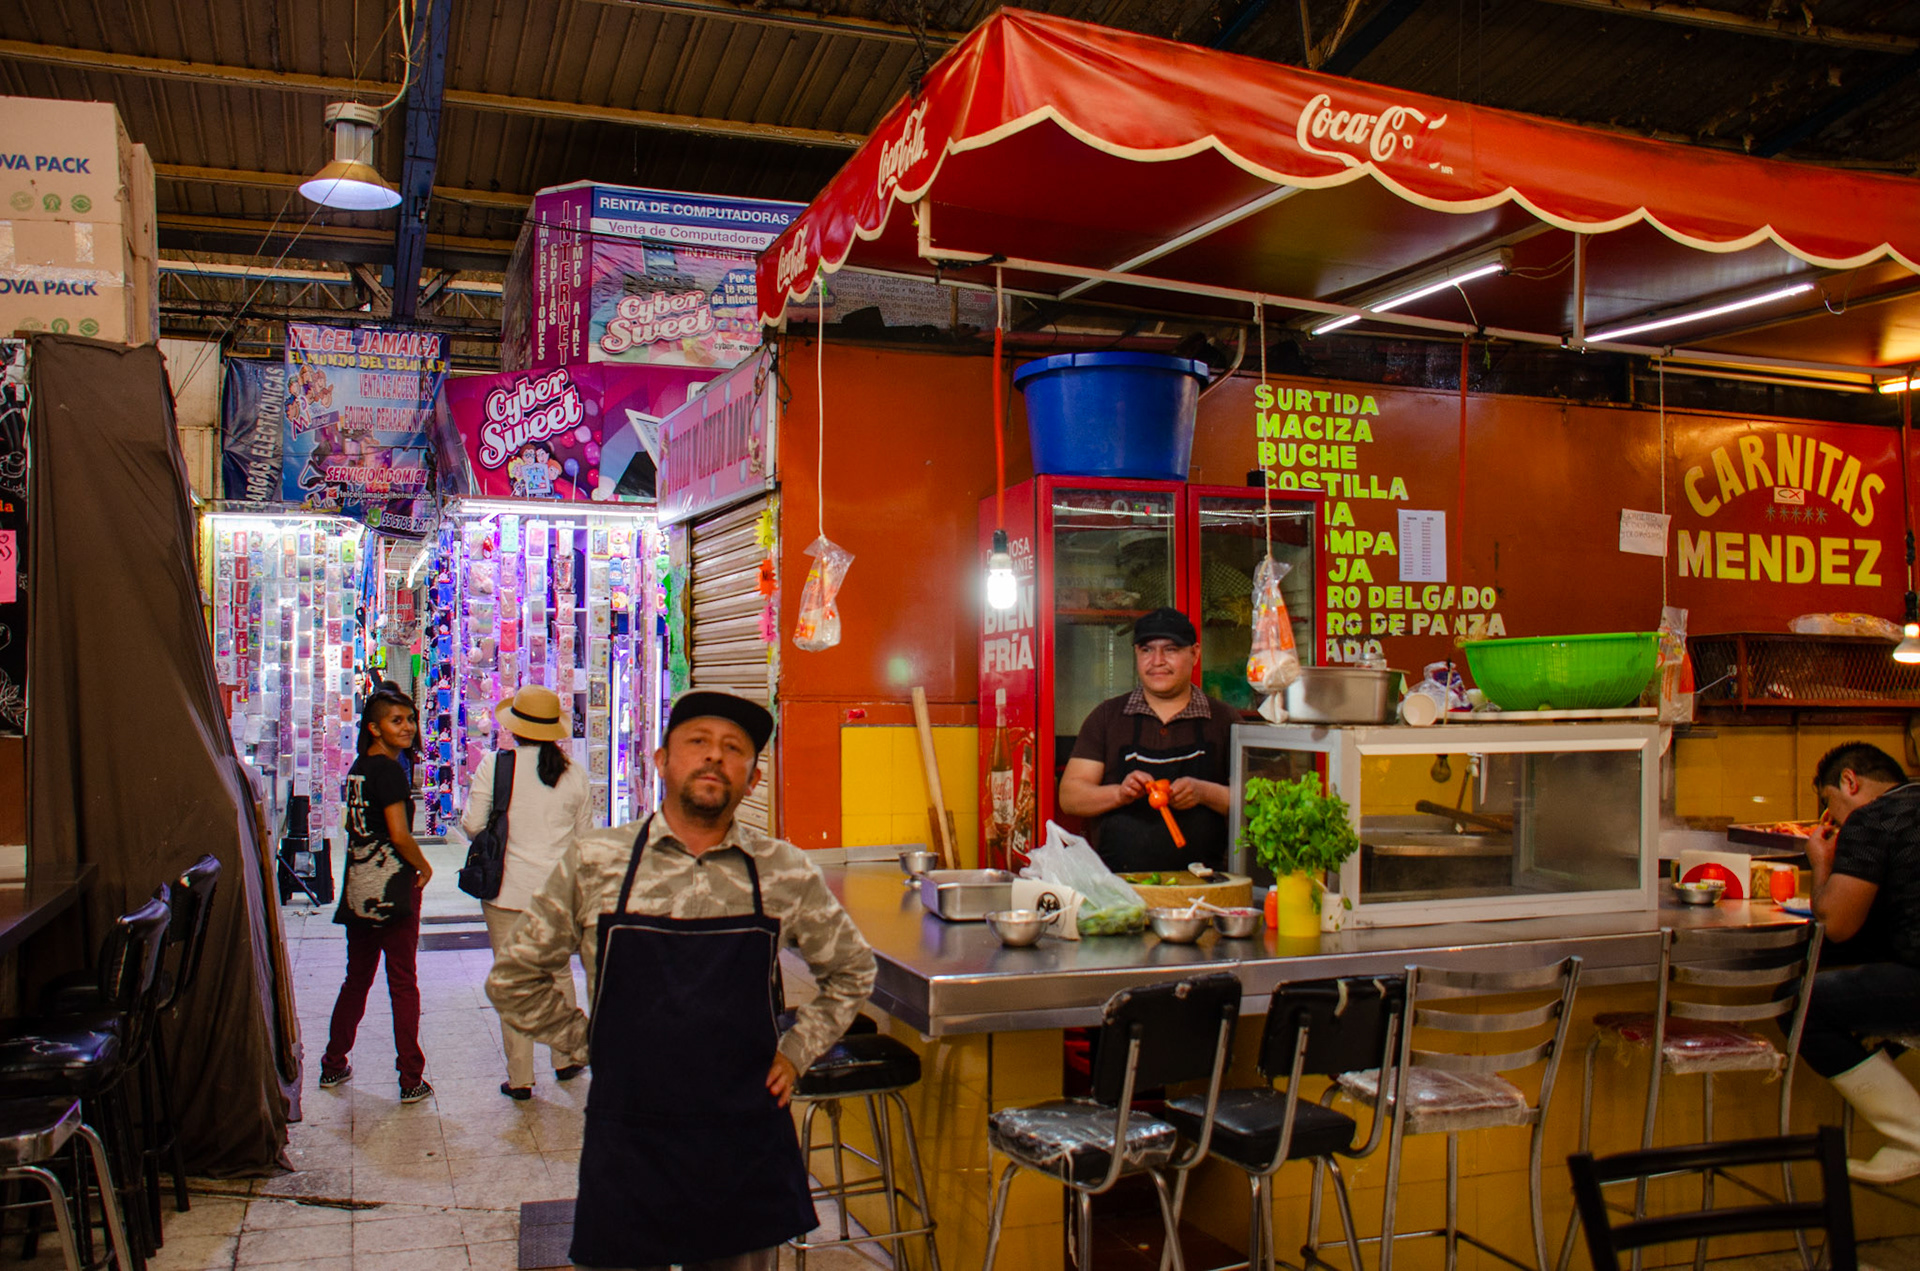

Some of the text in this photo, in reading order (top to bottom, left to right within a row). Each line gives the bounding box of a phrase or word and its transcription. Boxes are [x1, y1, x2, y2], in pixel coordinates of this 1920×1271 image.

[0, 153, 91, 174] VA PACK
[878, 97, 929, 200] Coca-Cola
[599, 197, 790, 225] RENTA DE COMPUTADORAS
[608, 221, 645, 236] Venta
[650, 225, 666, 237] de
[670, 227, 766, 246] Computadoras
[684, 247, 746, 262] INTERNET
[776, 223, 808, 294] Coca-Cola
[44, 279, 99, 296] PACK
[537, 211, 549, 361] IMPRESIONES
[549, 243, 558, 325] COPIAS
[557, 200, 572, 366] INTERNET
[571, 205, 583, 357] TIEMPO AIRE
[724, 284, 735, 294] te
[729, 272, 748, 284] Por
[617, 290, 706, 325] Cyber
[711, 294, 724, 305] de
[288, 326, 441, 359] TELCEL JAMAICA
[601, 304, 716, 354] Sweet
[288, 350, 303, 365] EL
[305, 352, 357, 368] MUNDO
[359, 354, 384, 370] DEL
[359, 373, 434, 402] VENTA DE ACCESOOS
[485, 367, 570, 428] Cyber
[1254, 384, 1380, 416] SURTIDA
[479, 385, 584, 470] Sweet
[1256, 412, 1373, 443] MACIZA
[1258, 441, 1358, 470] BUCHE
[325, 465, 377, 484] SERVICIO
[377, 469, 386, 484] A
[1266, 470, 1409, 500] COSTILLA
[1683, 432, 1886, 527] CARNITAS
[1677, 529, 1883, 587] MENDEZ
[1368, 585, 1496, 611] DELGADO
[1370, 612, 1406, 636] DE
[1412, 612, 1507, 637] PANZA
